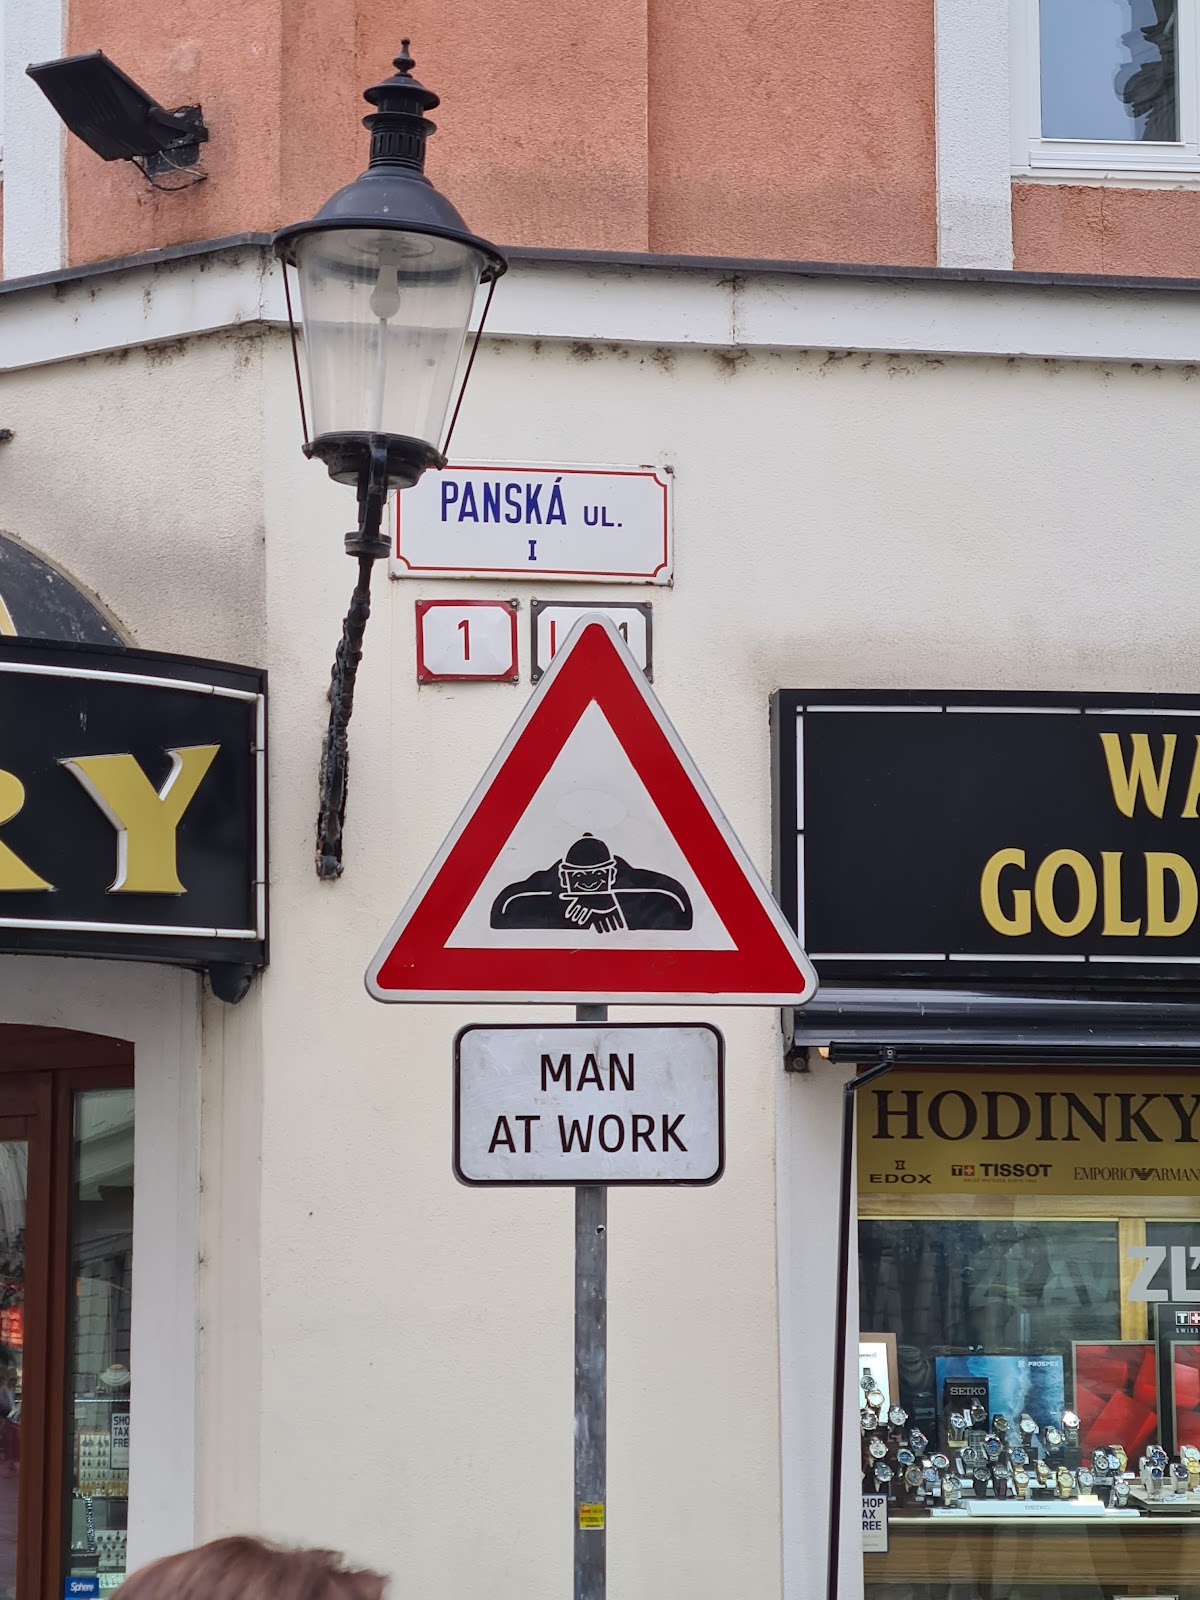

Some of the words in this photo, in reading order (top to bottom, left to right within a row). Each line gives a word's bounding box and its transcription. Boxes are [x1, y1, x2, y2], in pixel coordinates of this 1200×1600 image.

[441, 477, 567, 525] PANSKÁ
[583, 506, 623, 527] UL.
[528, 540, 537, 560] I
[458, 620, 470, 660] 1
[1098, 732, 1200, 819] W
[980, 847, 1199, 937] GOLD
[540, 1053, 635, 1091] MAN
[487, 1115, 541, 1153] AT
[557, 1114, 688, 1153] WORK
[871, 1089, 1200, 1143] HODINKY
[869, 1174, 932, 1184] EDOX
[980, 1163, 1052, 1177] TISSOT
[1074, 1167, 1134, 1180] EMPORIO
[950, 1387, 987, 1396] SEIKO
[113, 1427, 129, 1437] TAX
